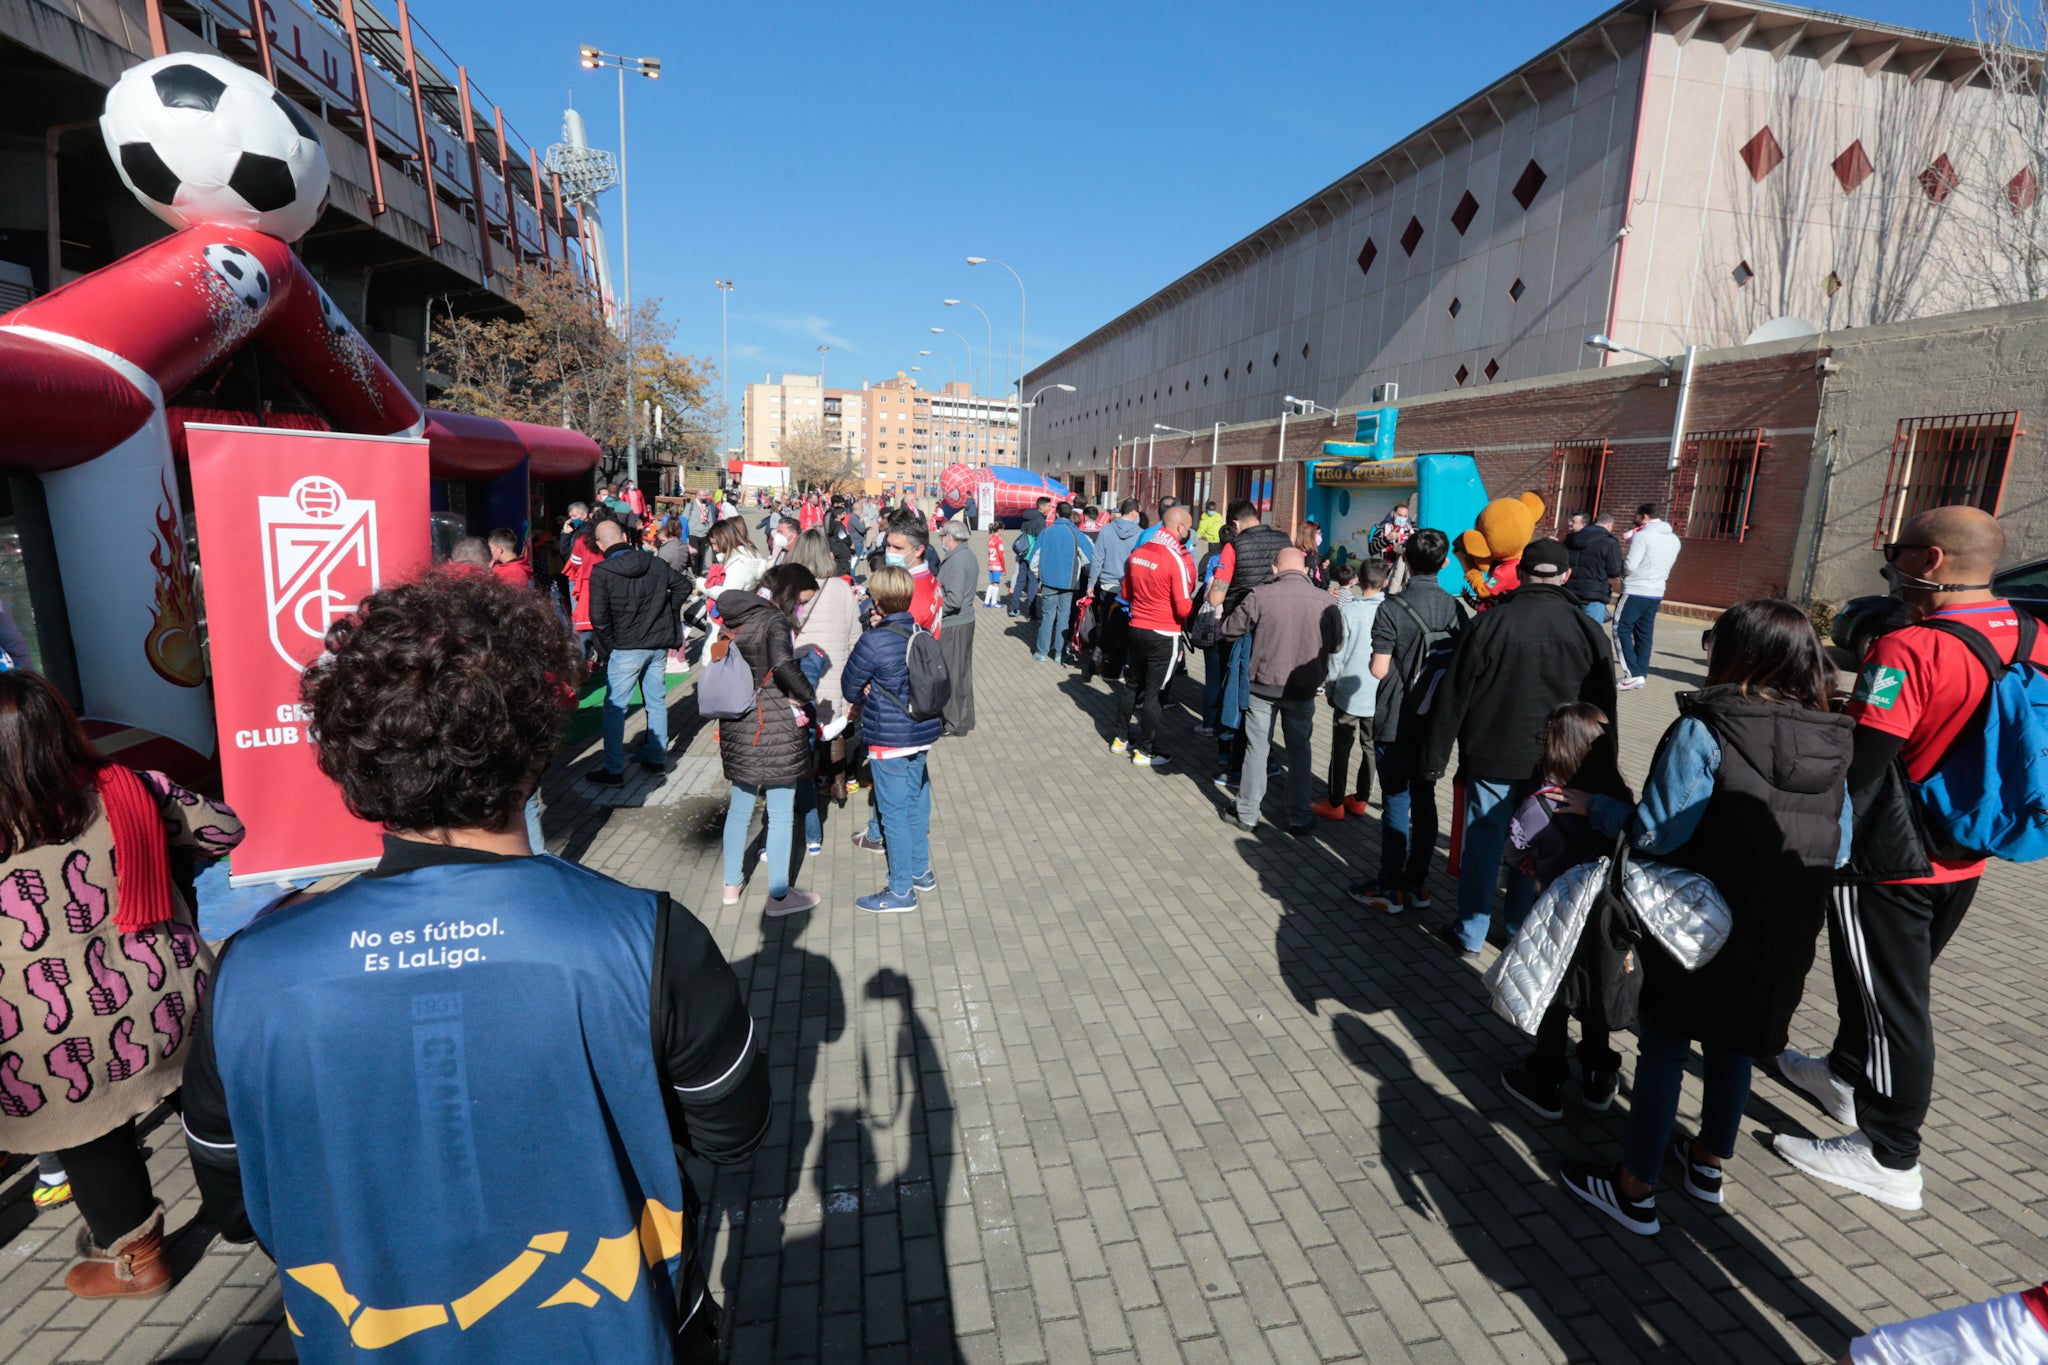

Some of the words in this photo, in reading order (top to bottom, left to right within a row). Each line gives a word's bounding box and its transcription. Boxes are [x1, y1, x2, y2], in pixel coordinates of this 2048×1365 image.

[1315, 468, 1342, 480] TIRO
[1345, 471, 1353, 479] A
[1356, 464, 1413, 480] PUERTA
[276, 703, 315, 723] GR
[235, 726, 299, 749] CLUB
[350, 930, 382, 949] No
[389, 929, 416, 945] es
[423, 917, 505, 942] fútbol.
[364, 953, 390, 972] Es
[398, 946, 487, 969] LaLiga.
